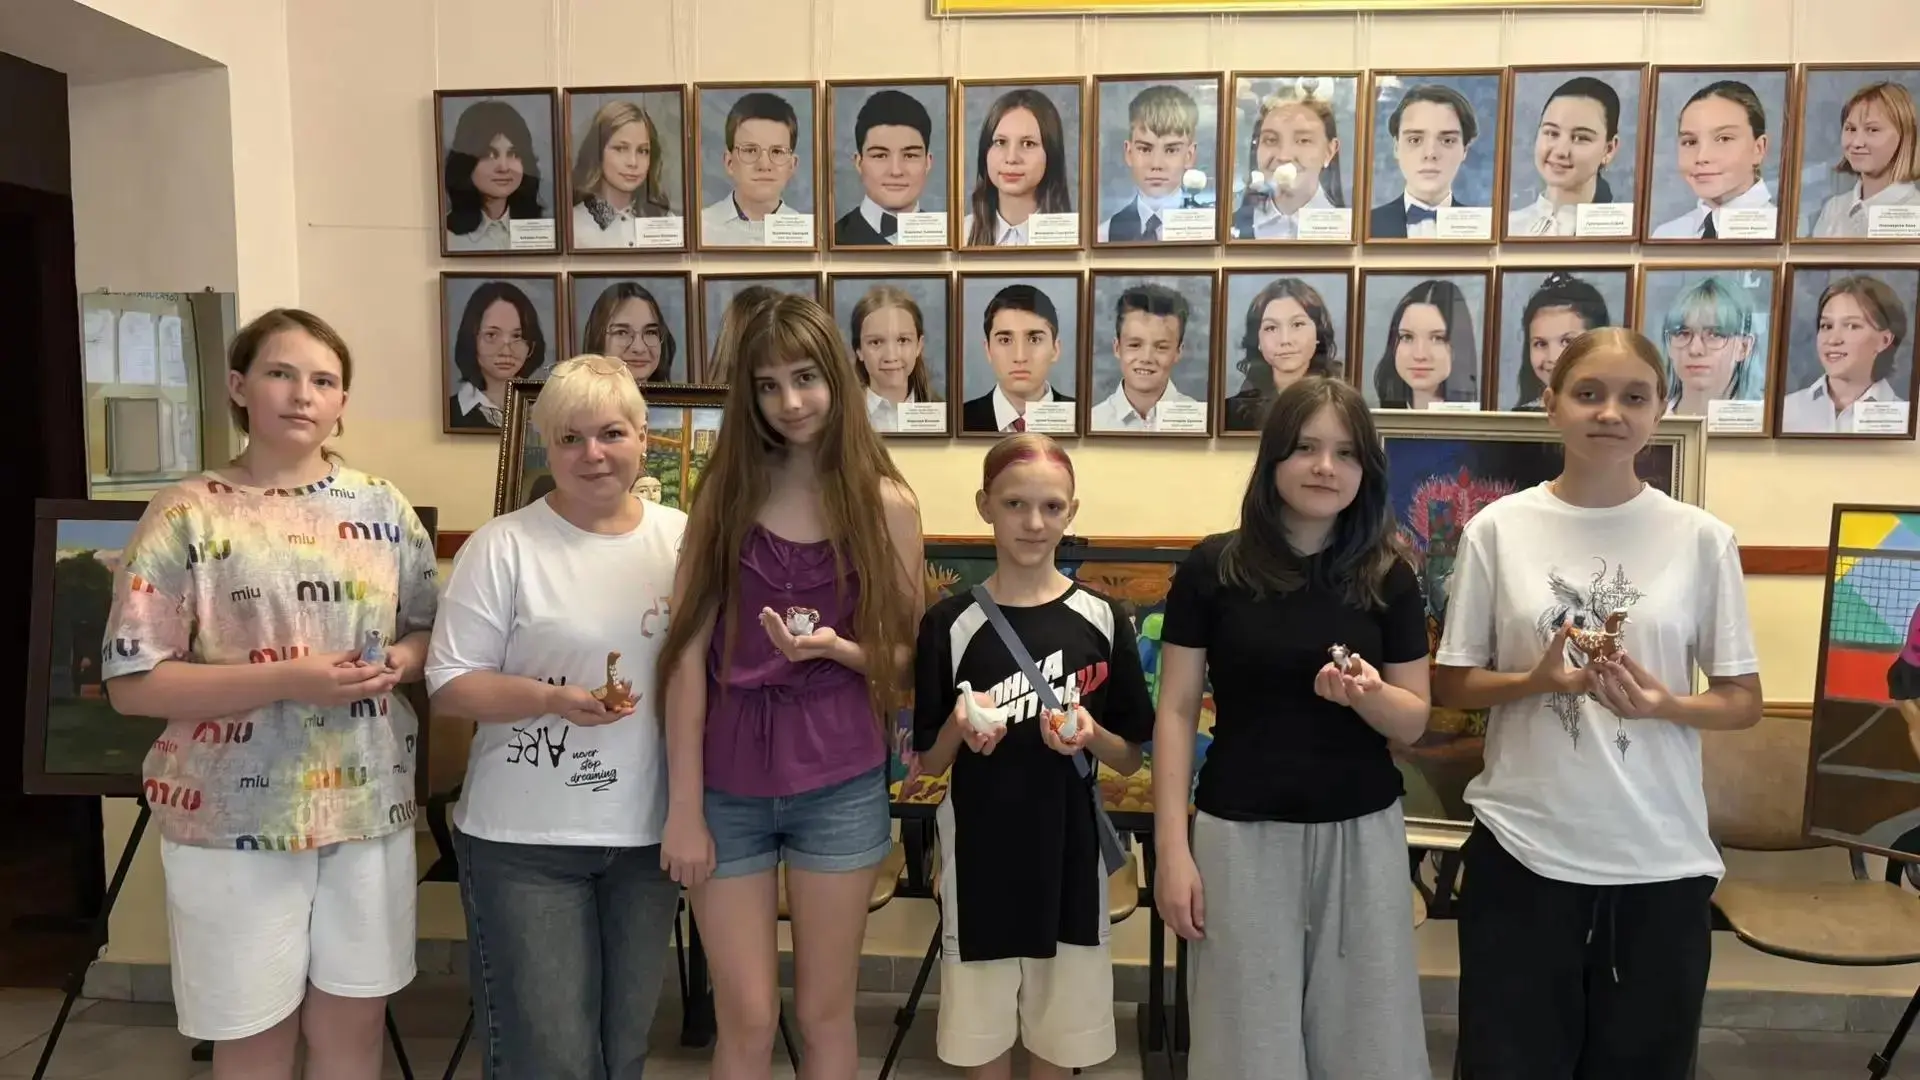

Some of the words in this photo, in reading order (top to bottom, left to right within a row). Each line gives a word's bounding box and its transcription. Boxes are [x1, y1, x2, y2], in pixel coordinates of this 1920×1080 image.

[231, 586, 261, 601] miu
[573, 749, 599, 759] never
[580, 758, 601, 772] stop
[239, 775, 270, 789] miu
[571, 768, 617, 783] dreaming
